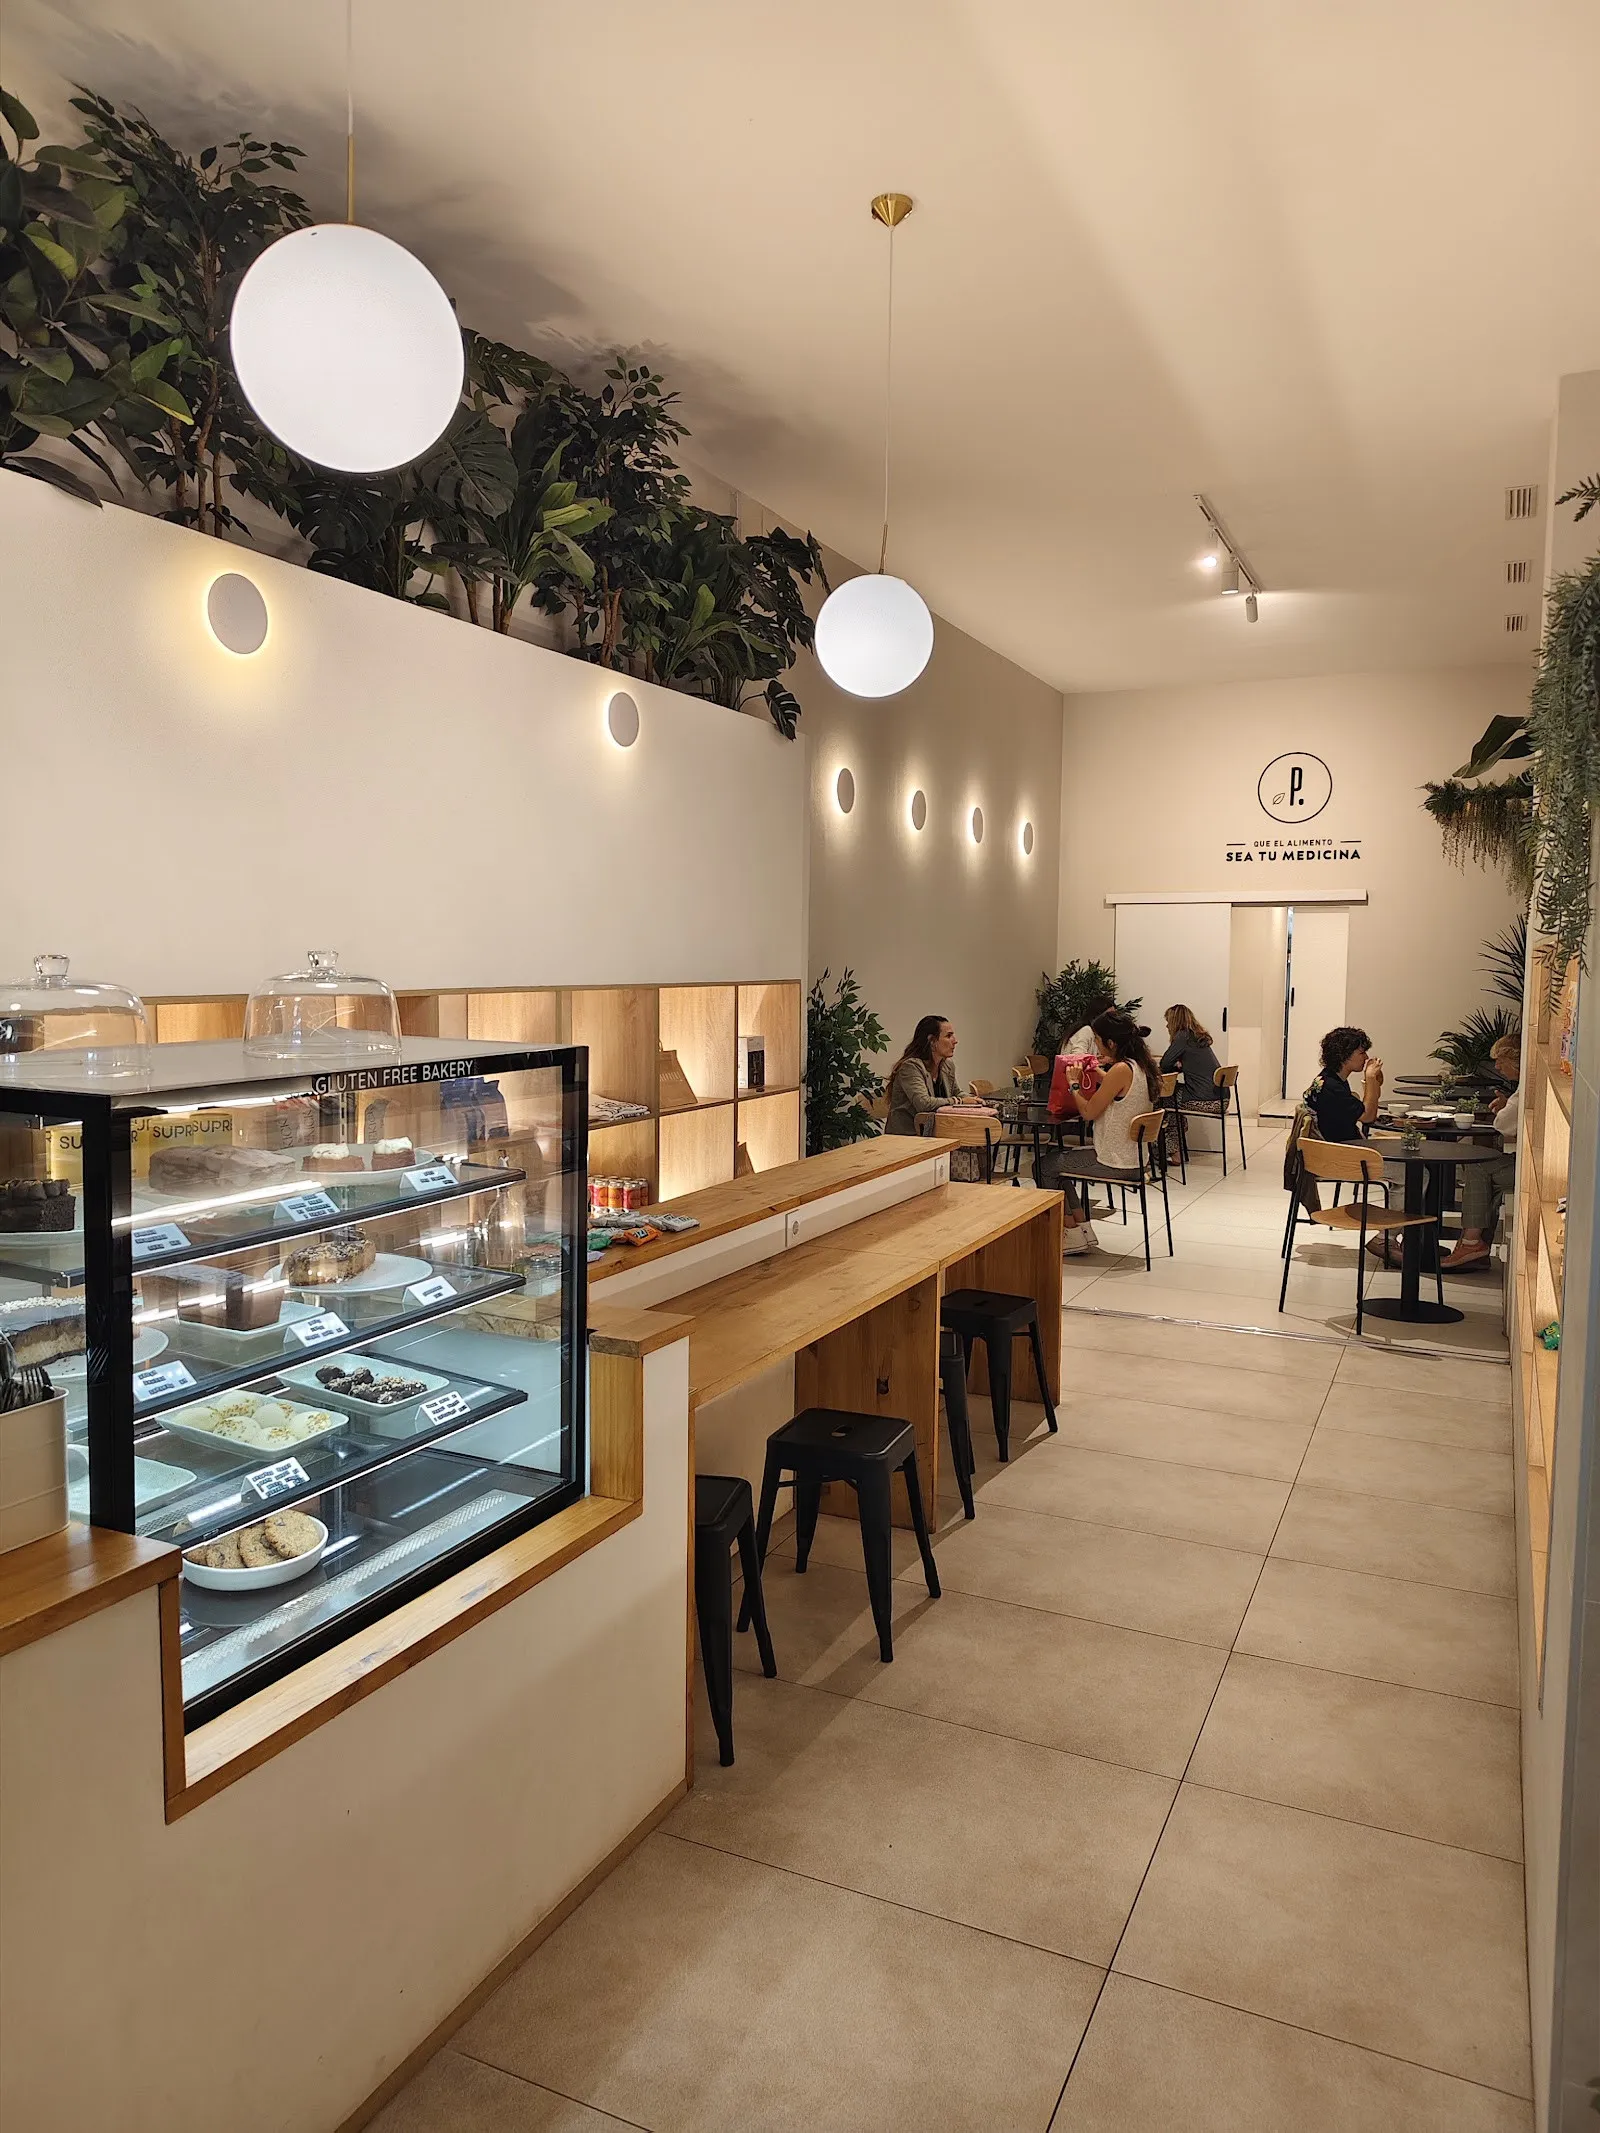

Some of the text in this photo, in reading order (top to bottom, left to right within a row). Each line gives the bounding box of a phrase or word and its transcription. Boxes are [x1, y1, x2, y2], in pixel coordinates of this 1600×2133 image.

[1253, 840, 1271, 848] QUE
[1287, 838, 1333, 847] ALIMENTO
[1225, 849, 1361, 862] SEA TU MEDICINA
[315, 1060, 474, 1094] GLUTEN FREE BAKERY
